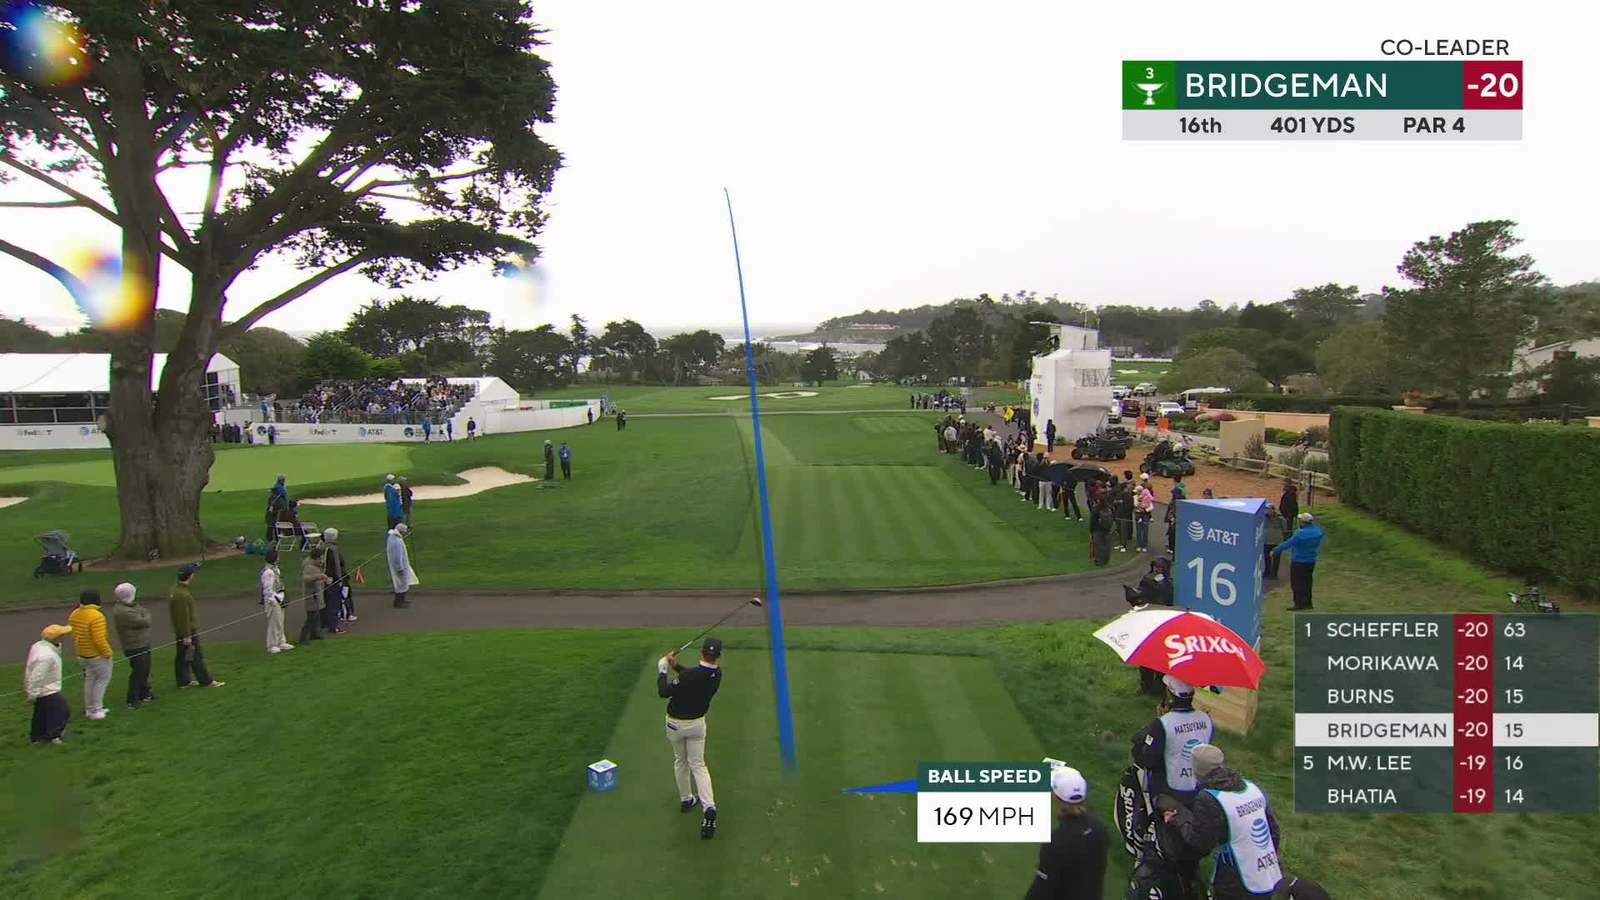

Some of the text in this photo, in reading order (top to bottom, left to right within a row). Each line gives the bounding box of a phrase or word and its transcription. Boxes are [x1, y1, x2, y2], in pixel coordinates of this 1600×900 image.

[1206, 526, 1240, 546] AT&T
[1186, 556, 1238, 607] 16
[1120, 784, 1135, 841] SRIXON
